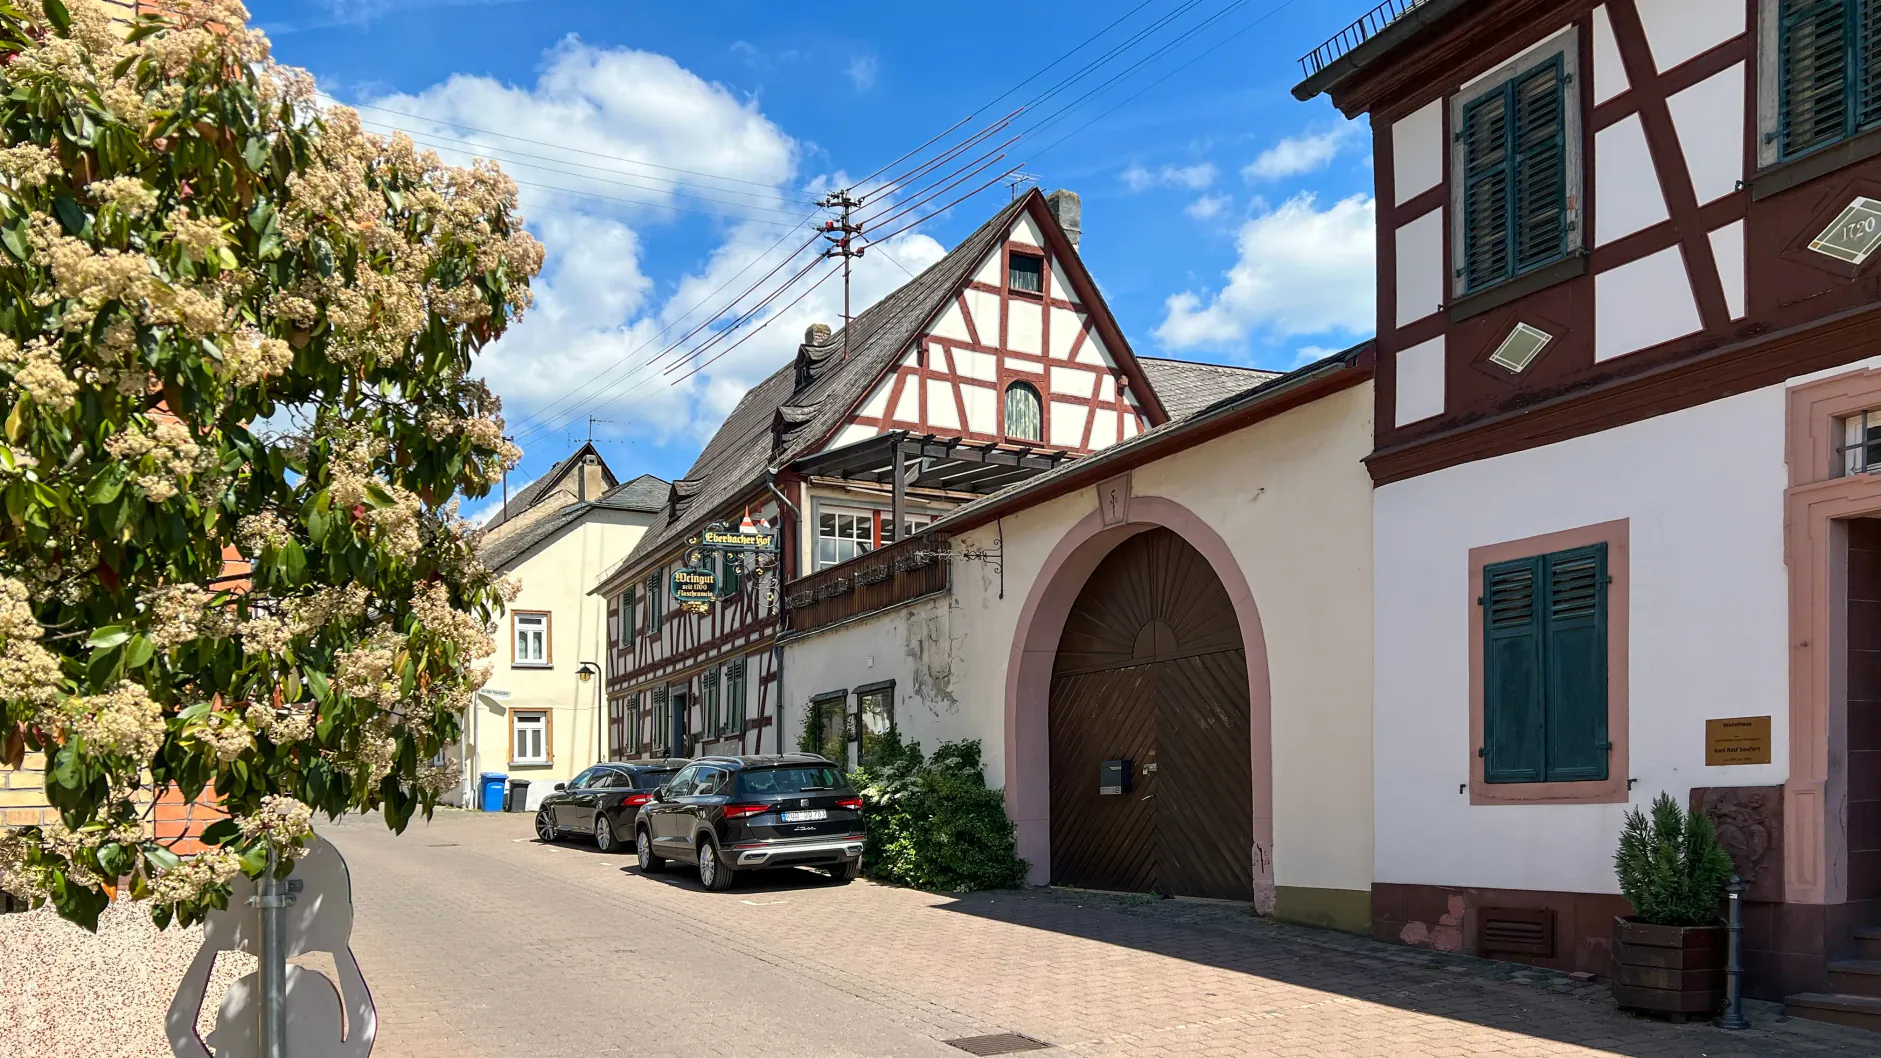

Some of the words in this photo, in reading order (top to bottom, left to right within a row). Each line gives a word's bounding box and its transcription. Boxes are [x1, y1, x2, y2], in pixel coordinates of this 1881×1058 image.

[1842, 217, 1875, 242] 1720
[705, 532, 755, 544] Eberbacher
[756, 533, 772, 547] Hof
[674, 572, 714, 585] Weingut
